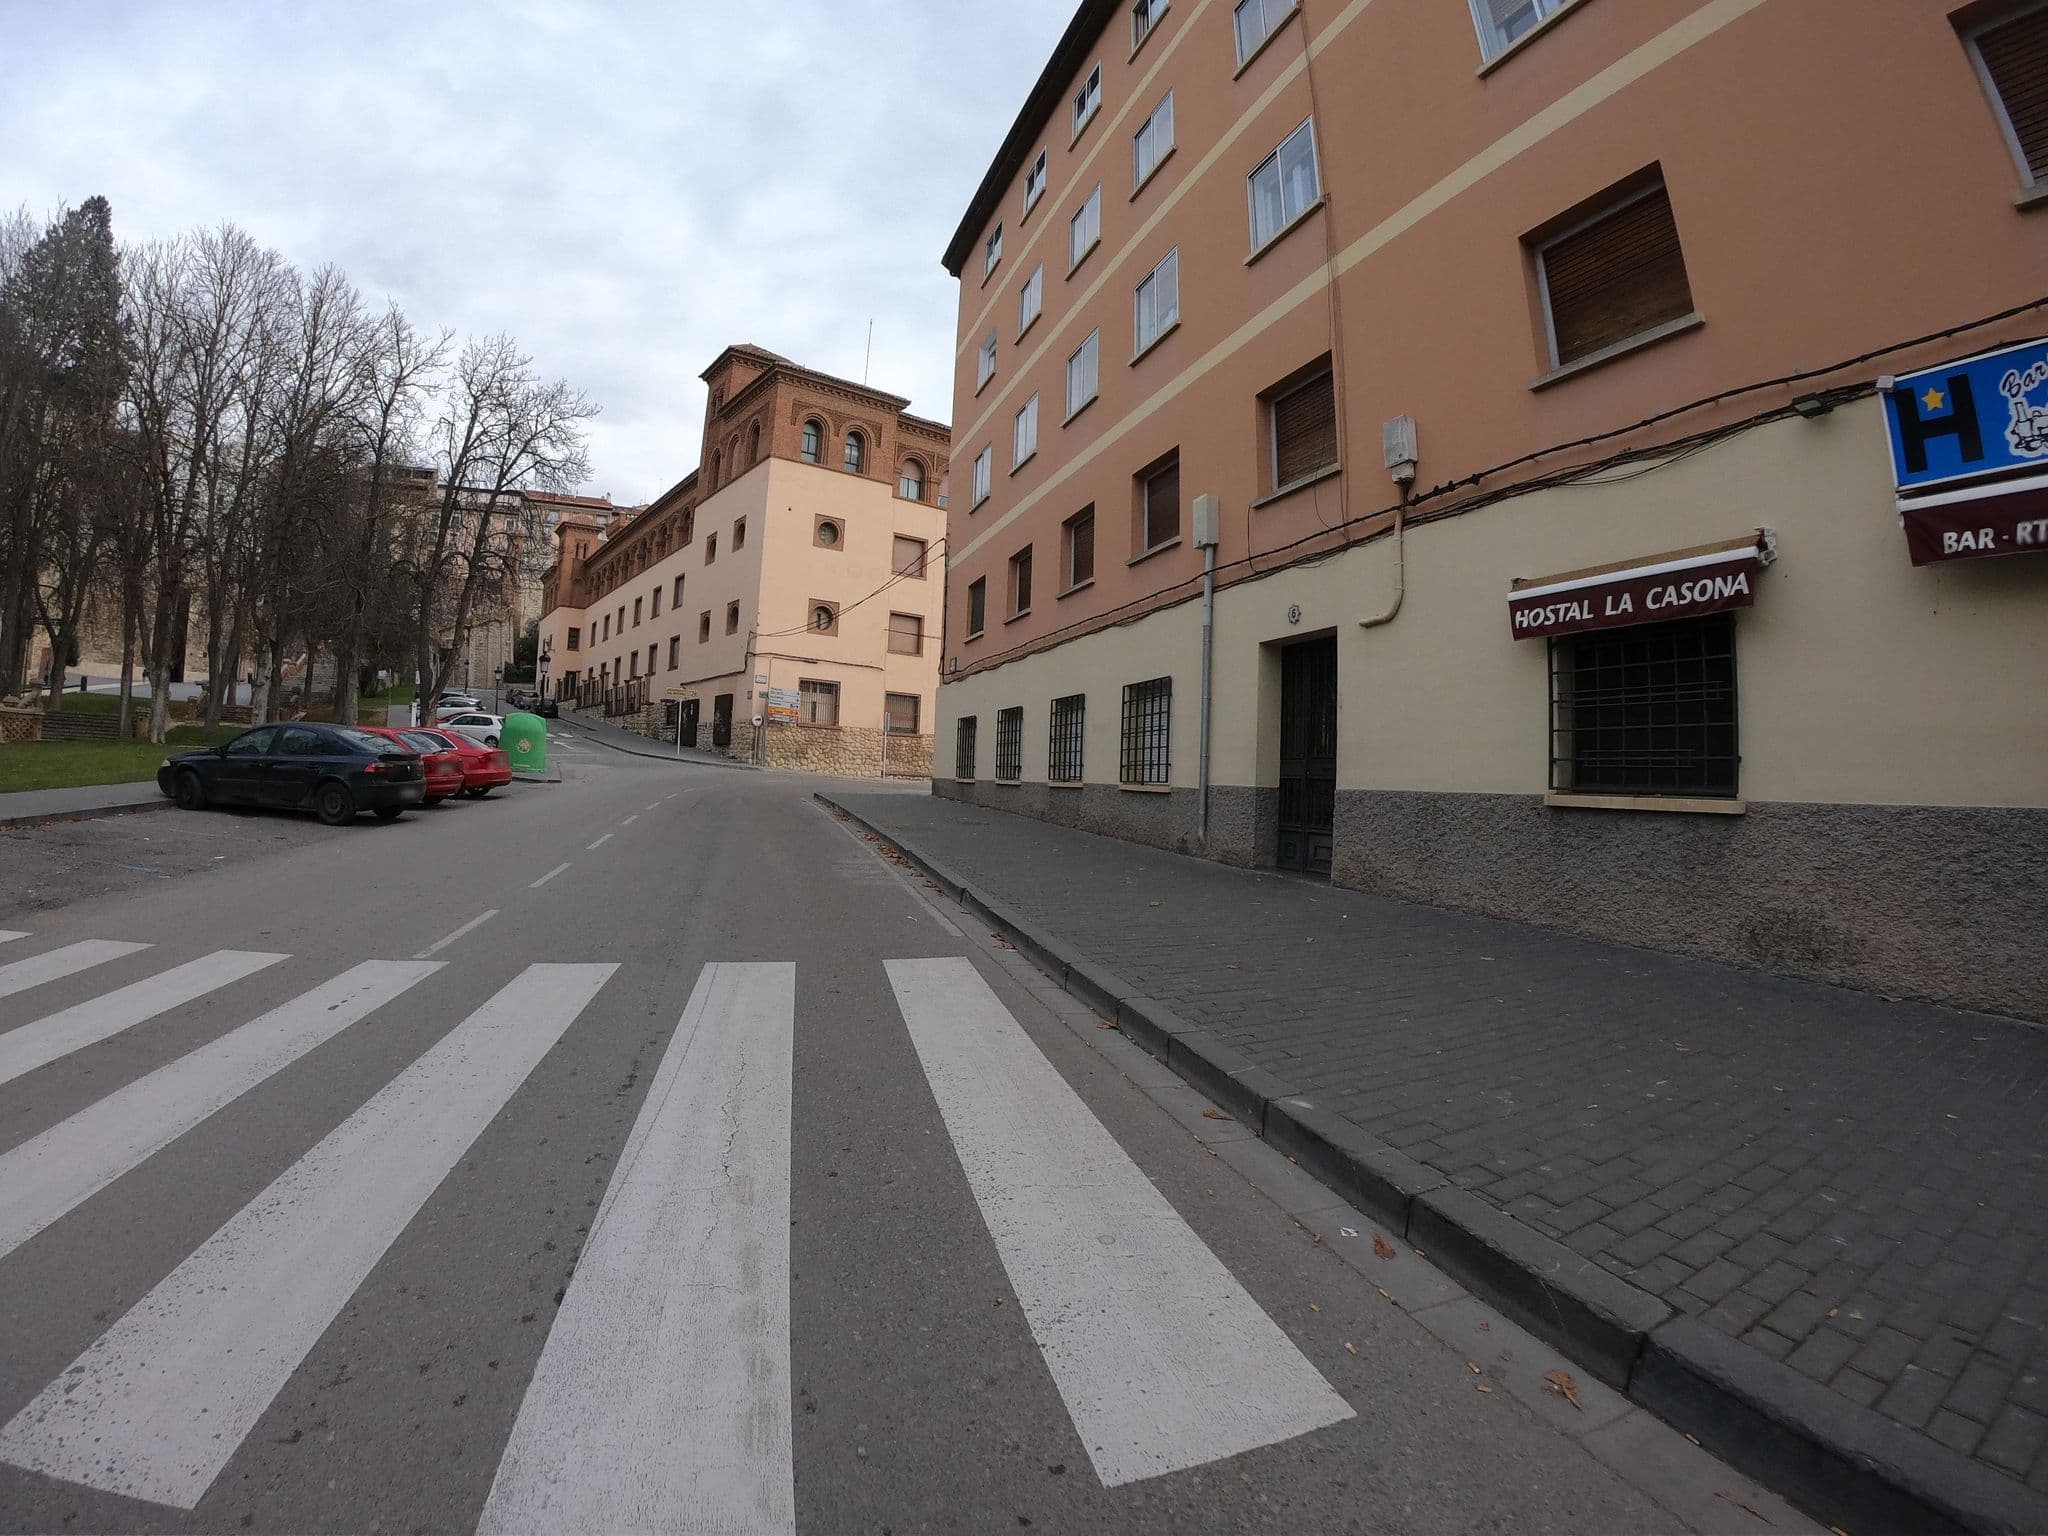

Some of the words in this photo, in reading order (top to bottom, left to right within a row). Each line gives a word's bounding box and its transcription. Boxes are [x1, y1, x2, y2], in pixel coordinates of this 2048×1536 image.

[1894, 373, 1984, 474] H
[1943, 527, 1996, 554] BAR
[1515, 599, 1594, 629] HOSTAL
[1604, 592, 1634, 616] LA
[1645, 572, 1750, 610] CASONA
